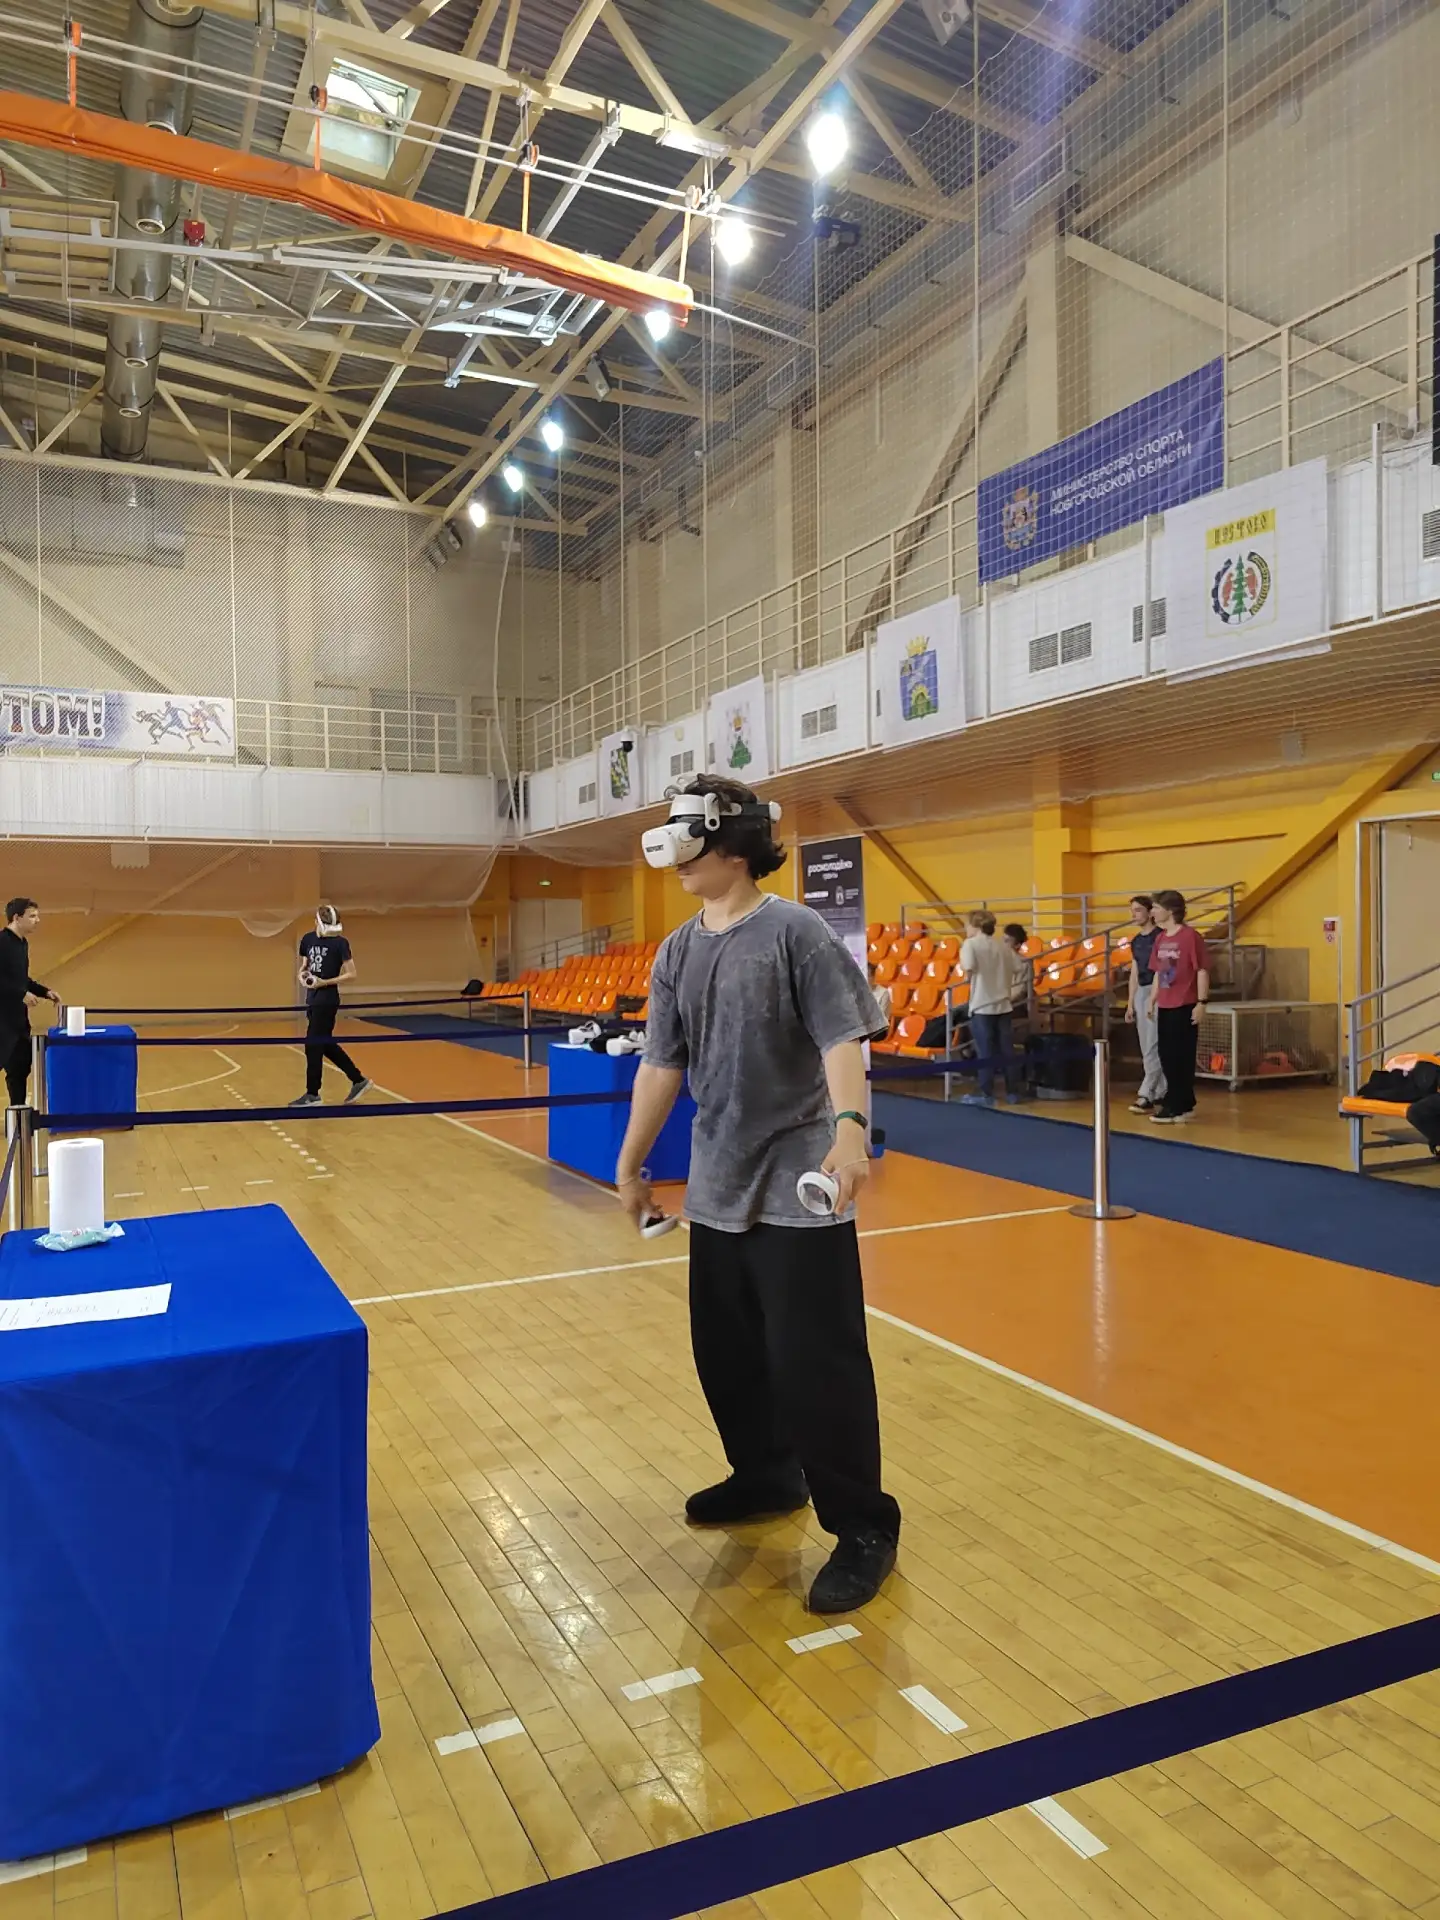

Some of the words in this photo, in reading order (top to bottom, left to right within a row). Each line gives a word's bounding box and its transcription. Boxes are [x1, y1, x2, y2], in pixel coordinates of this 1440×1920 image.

[1050, 452, 1134, 501] МИНИСТЕРСТВО
[1135, 429, 1184, 460] СПОРТА
[1050, 467, 1137, 516] НОВГОРОДСКОЙ
[1137, 442, 1192, 478] ОБЛАСТИ
[0, 689, 103, 738] ТОМ!
